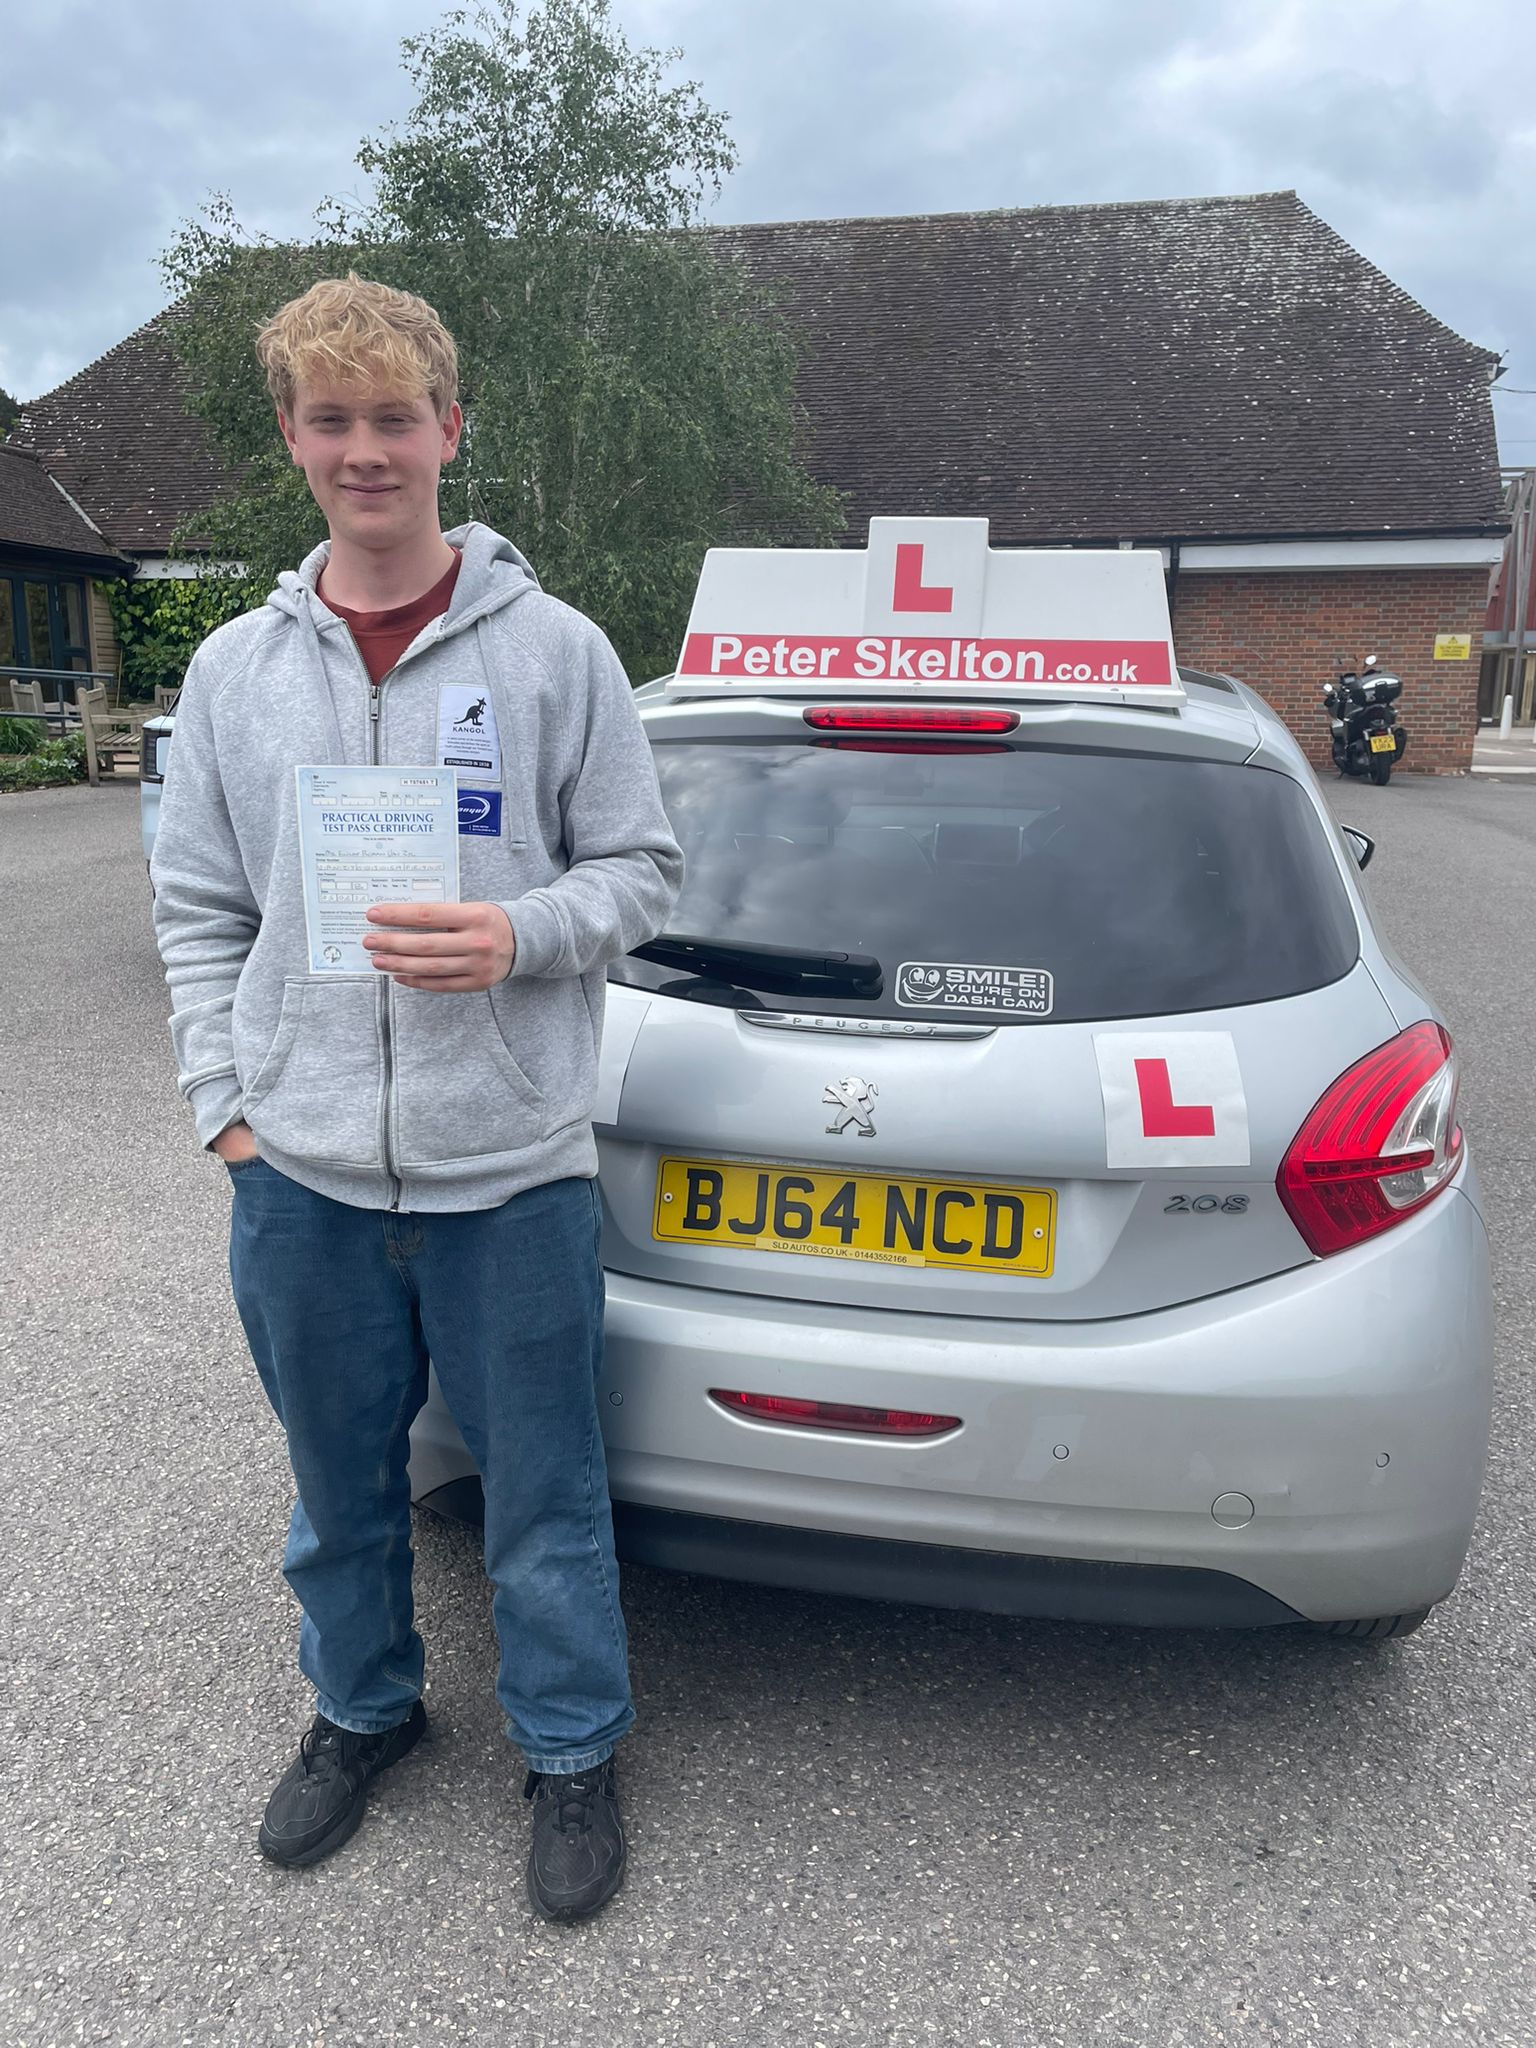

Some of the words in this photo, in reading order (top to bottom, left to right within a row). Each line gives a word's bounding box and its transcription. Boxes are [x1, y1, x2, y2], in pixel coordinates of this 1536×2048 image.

[893, 543, 953, 612] L
[710, 636, 839, 676] Peter
[855, 638, 1138, 683] Skelton.co.uk
[452, 726, 486, 734] KANGOL
[322, 812, 381, 823] PRACTICAL
[385, 812, 434, 823] DRIVING
[323, 823, 344, 832] TEST
[347, 823, 371, 832] PASS
[373, 823, 434, 832] CERTIFICATE
[945, 968, 1046, 989] SMILE!
[946, 983, 1012, 998] YOU'RE
[1018, 988, 1045, 999] ON
[944, 994, 996, 1006] DASH
[1002, 999, 1045, 1010] CAM
[792, 1017, 937, 1035] PEUGEOT
[1134, 1058, 1216, 1137] L
[682, 1168, 860, 1244] BJ64
[883, 1184, 1024, 1260] NCD
[1164, 1194, 1250, 1214] 208
[772, 1241, 789, 1250] SLD
[789, 1243, 848, 1257] AUTOS.CO.UK
[854, 1250, 908, 1264] 01443552166
